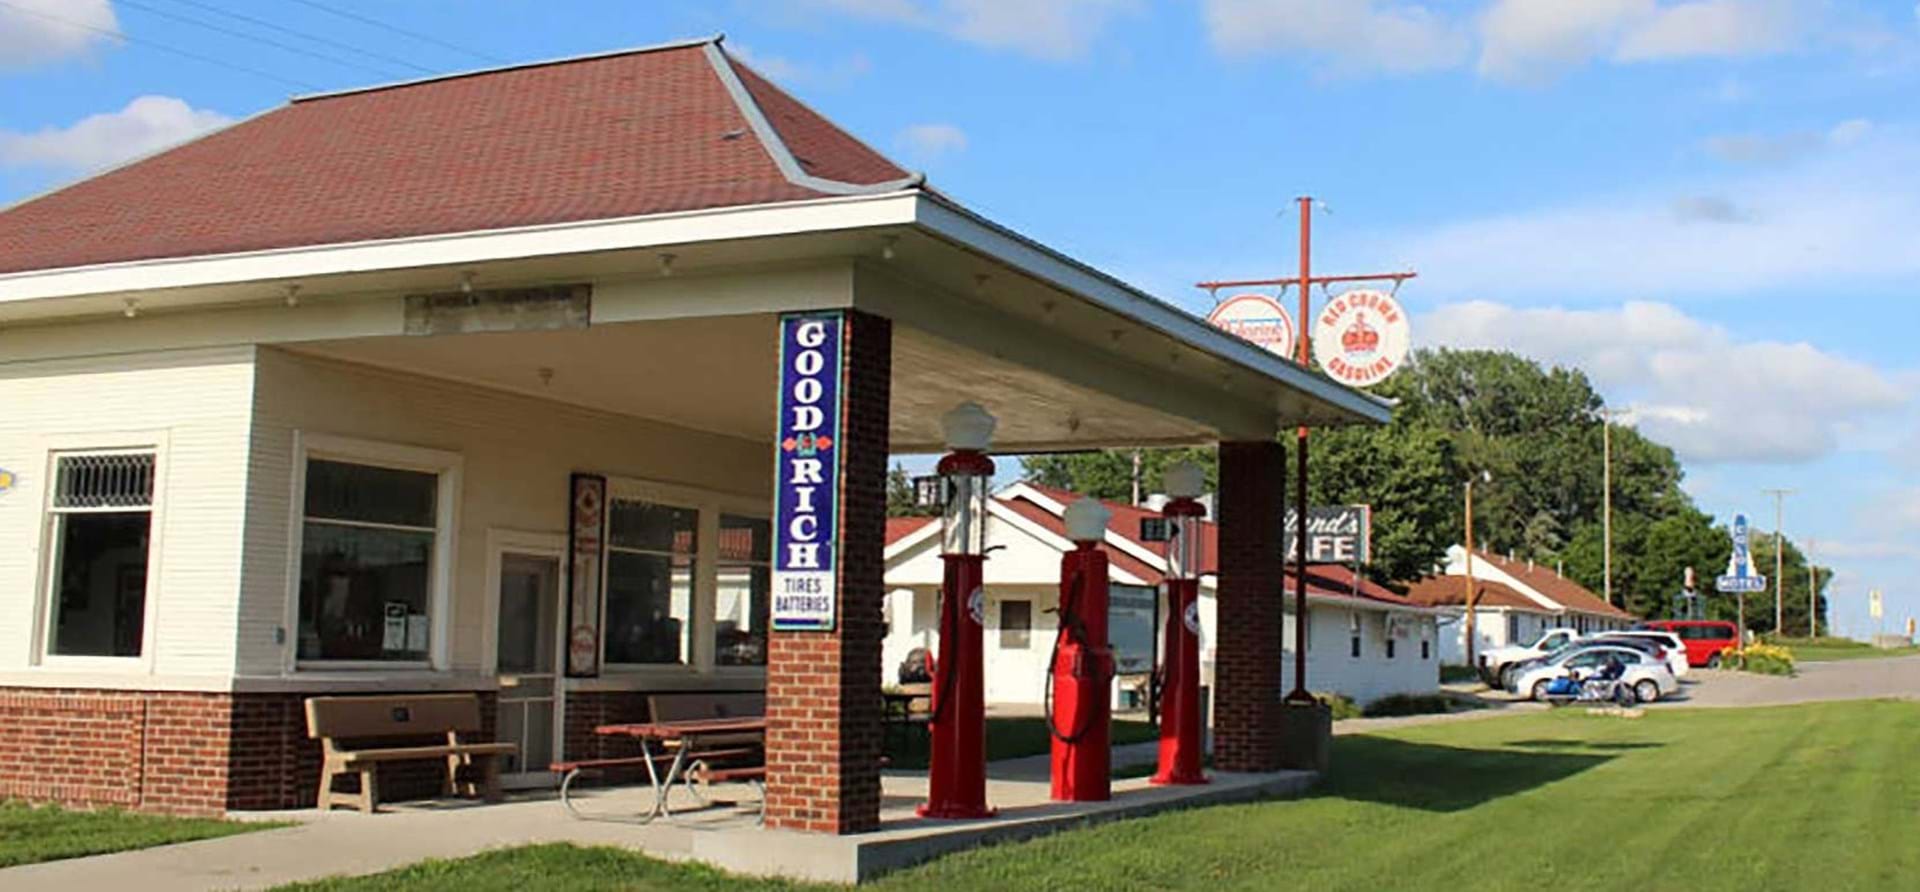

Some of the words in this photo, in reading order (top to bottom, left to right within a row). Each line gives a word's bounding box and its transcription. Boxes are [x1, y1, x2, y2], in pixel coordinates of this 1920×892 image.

[1322, 300, 1346, 327] RED
[1348, 293, 1398, 324] CROWN
[1328, 356, 1393, 380] GASOLINE
[1286, 536, 1355, 561] AFE
[784, 577, 822, 594] TIRES
[775, 595, 830, 613] BATTERIES
